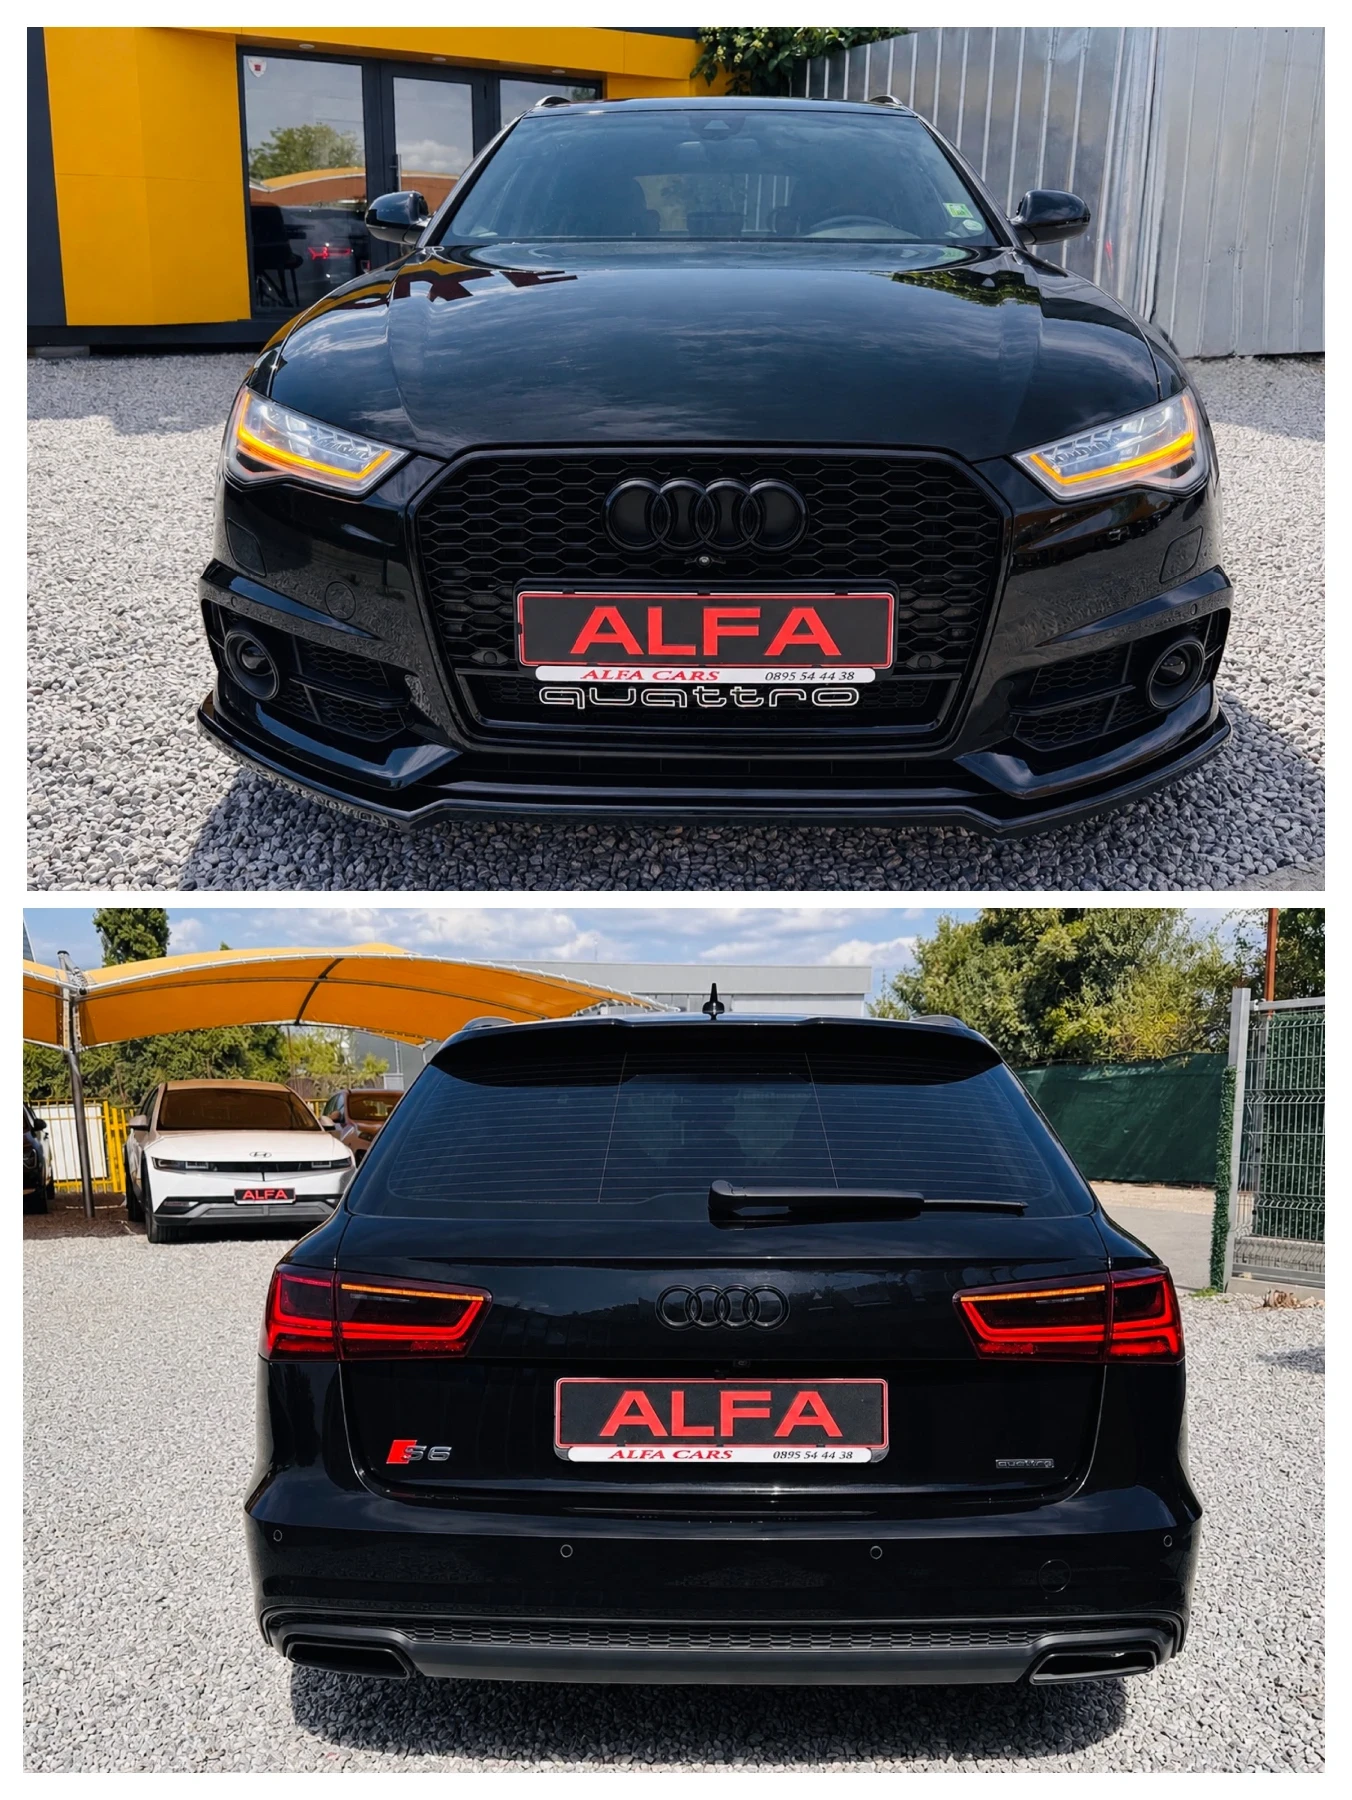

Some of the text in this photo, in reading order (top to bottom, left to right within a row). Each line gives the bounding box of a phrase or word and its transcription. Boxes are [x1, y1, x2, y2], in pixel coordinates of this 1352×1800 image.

[570, 606, 841, 656] ALFA
[581, 669, 855, 682] ALFA CARS 0895 54 44 38
[539, 686, 860, 710] quattro
[242, 1189, 288, 1200] ALFA
[600, 1390, 843, 1437] ALFA
[402, 1445, 452, 1461] S6
[608, 1449, 853, 1460] ALFA CARS 0895 54 44 38
